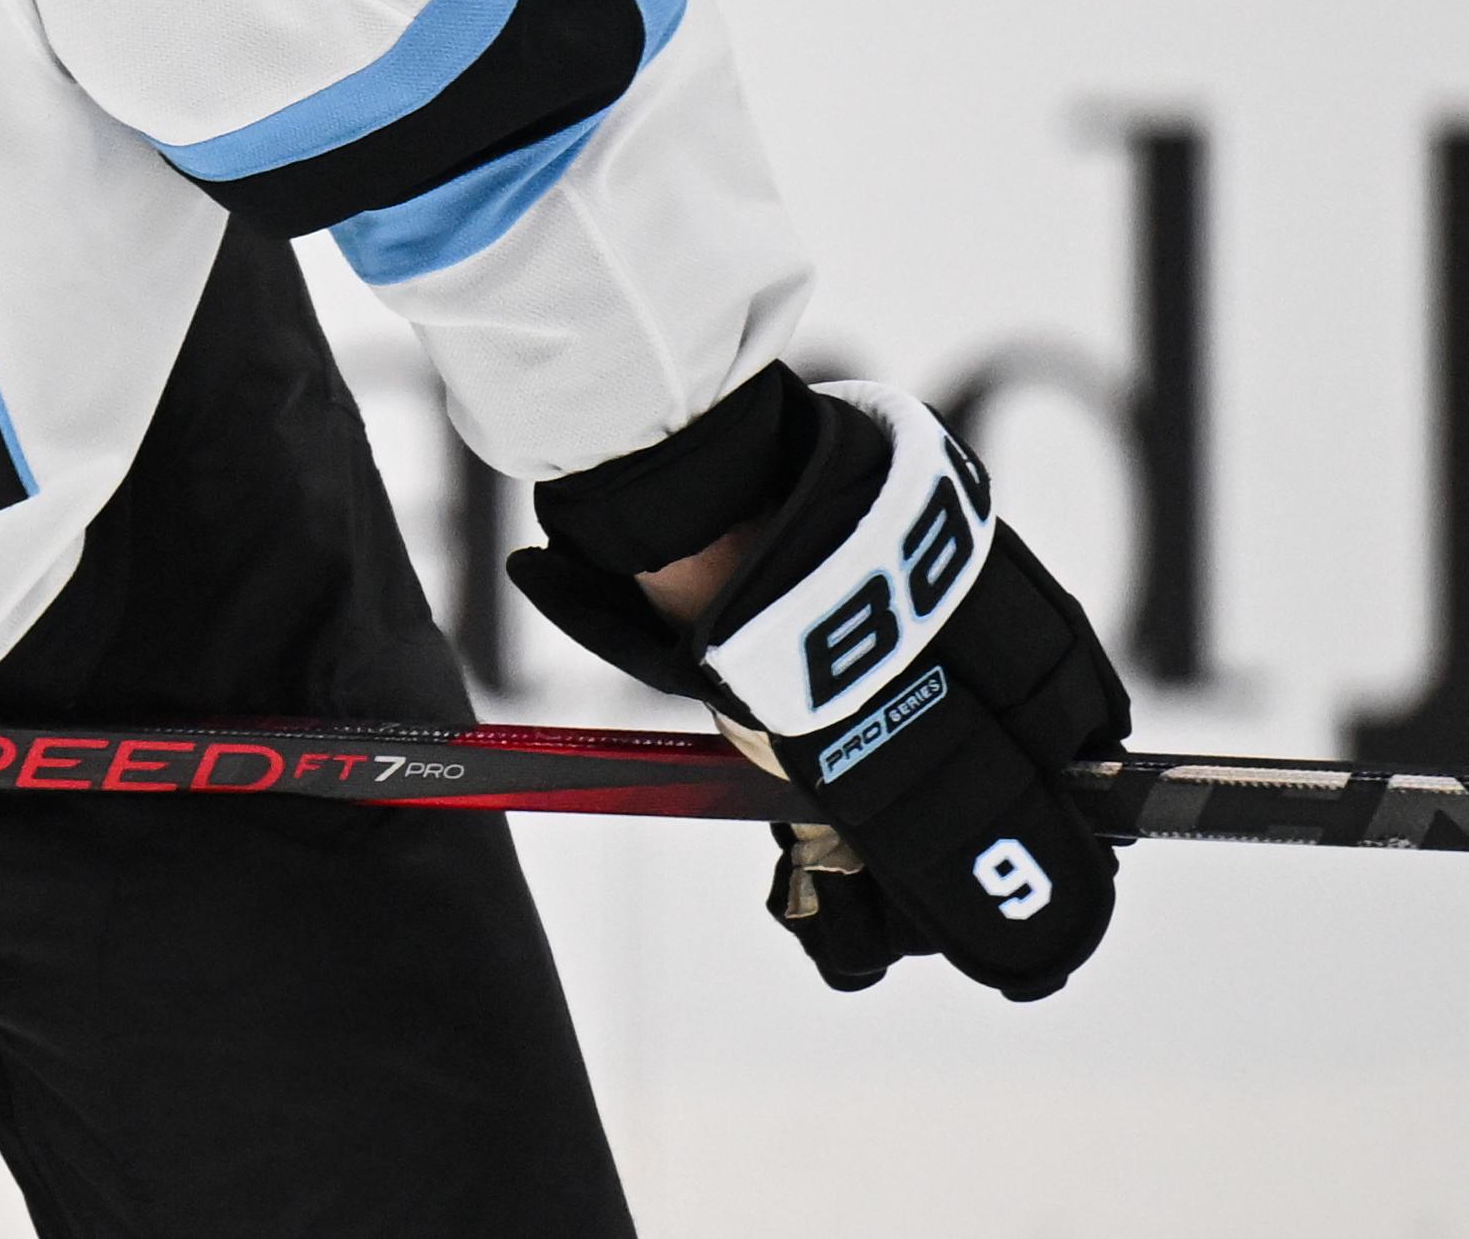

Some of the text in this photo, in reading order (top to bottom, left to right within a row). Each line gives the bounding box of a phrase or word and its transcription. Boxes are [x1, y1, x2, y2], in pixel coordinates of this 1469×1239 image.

[825, 678, 941, 772] PRO SERIES
[972, 838, 1053, 921] 9
